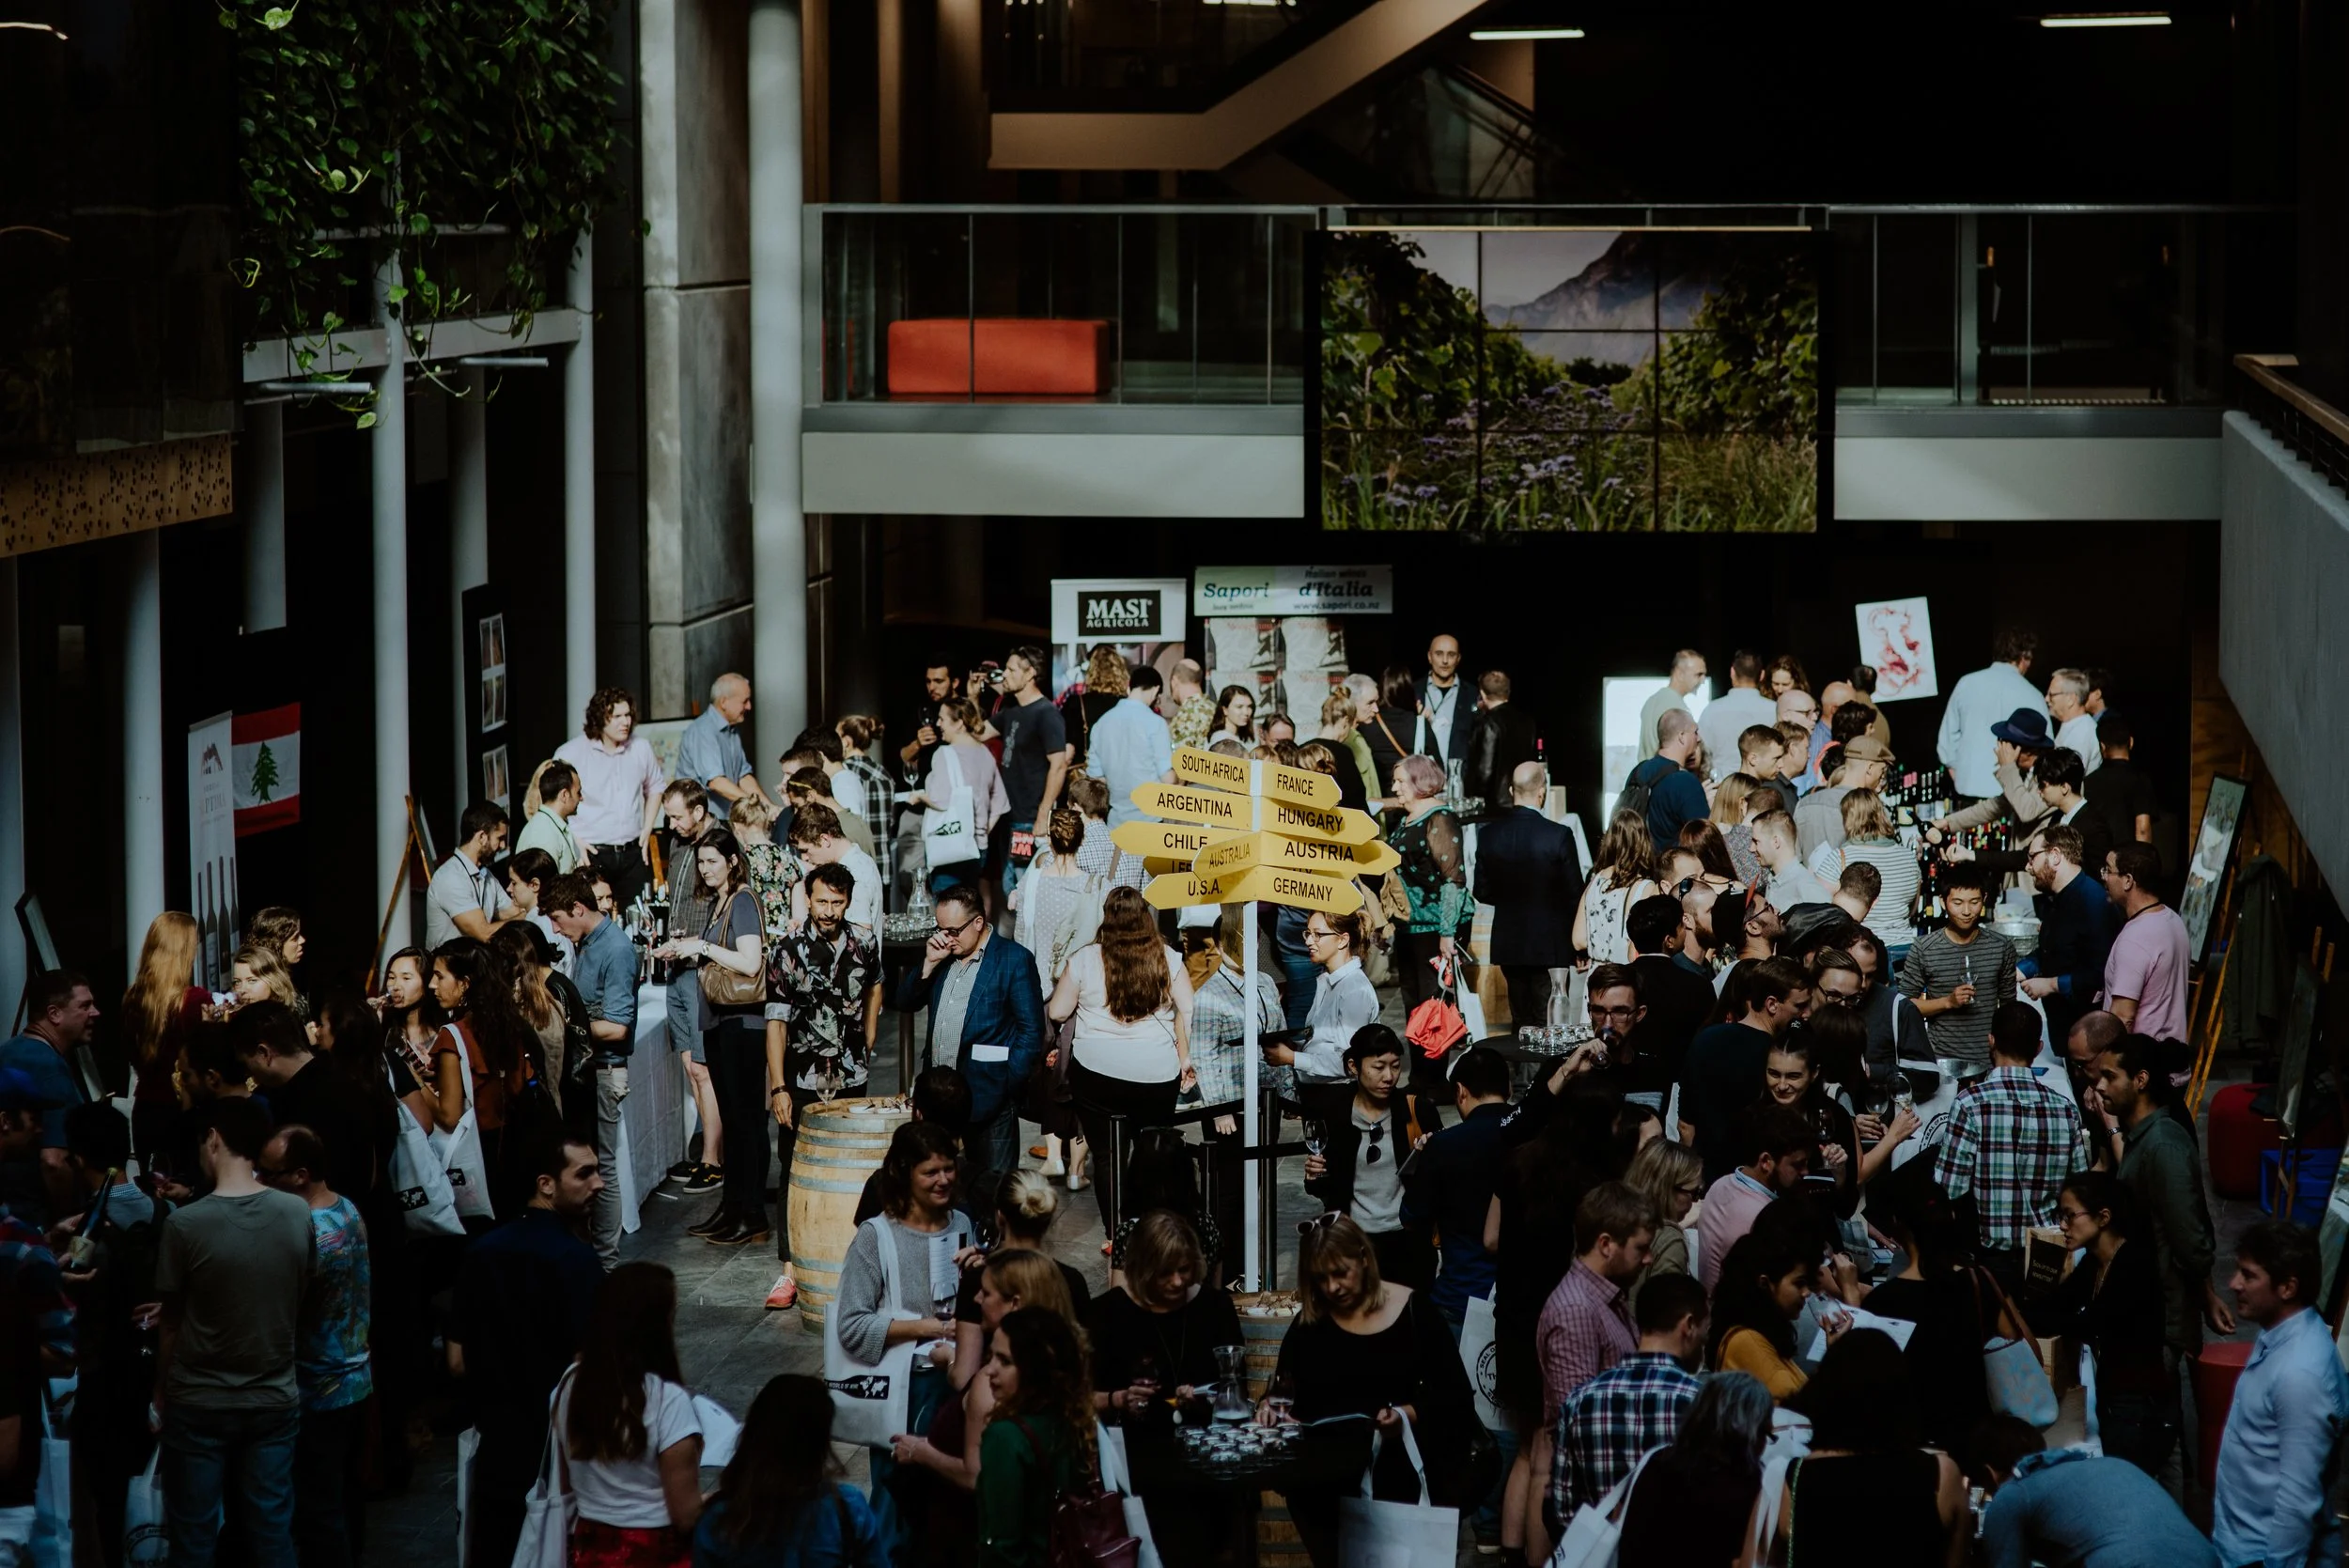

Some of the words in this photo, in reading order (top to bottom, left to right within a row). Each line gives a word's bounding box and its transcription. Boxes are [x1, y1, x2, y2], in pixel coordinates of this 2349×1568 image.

[1204, 582, 1269, 601] Sapori
[1299, 581, 1374, 598] d'Italia
[1086, 598, 1148, 619] MASI
[1293, 600, 1380, 612] www.sapori.co.nz
[1086, 618, 1149, 628] AGRICOLA
[1181, 754, 1211, 773] SOUTH
[1213, 761, 1245, 784] AFRICA
[1277, 773, 1315, 796] FRANCE
[1157, 792, 1233, 818] ARGENTINA
[1278, 807, 1344, 832] HUNGARY
[1163, 832, 1207, 851] CHILE
[1284, 841, 1355, 862] AUSTRIA
[1209, 843, 1251, 869] AUSTRALIA
[1188, 877, 1223, 896] U.S.A.
[1273, 877, 1333, 902] GERMANY
[1925, 1126, 1936, 1141] SEAL
[1480, 1354, 1491, 1369] SEAL
